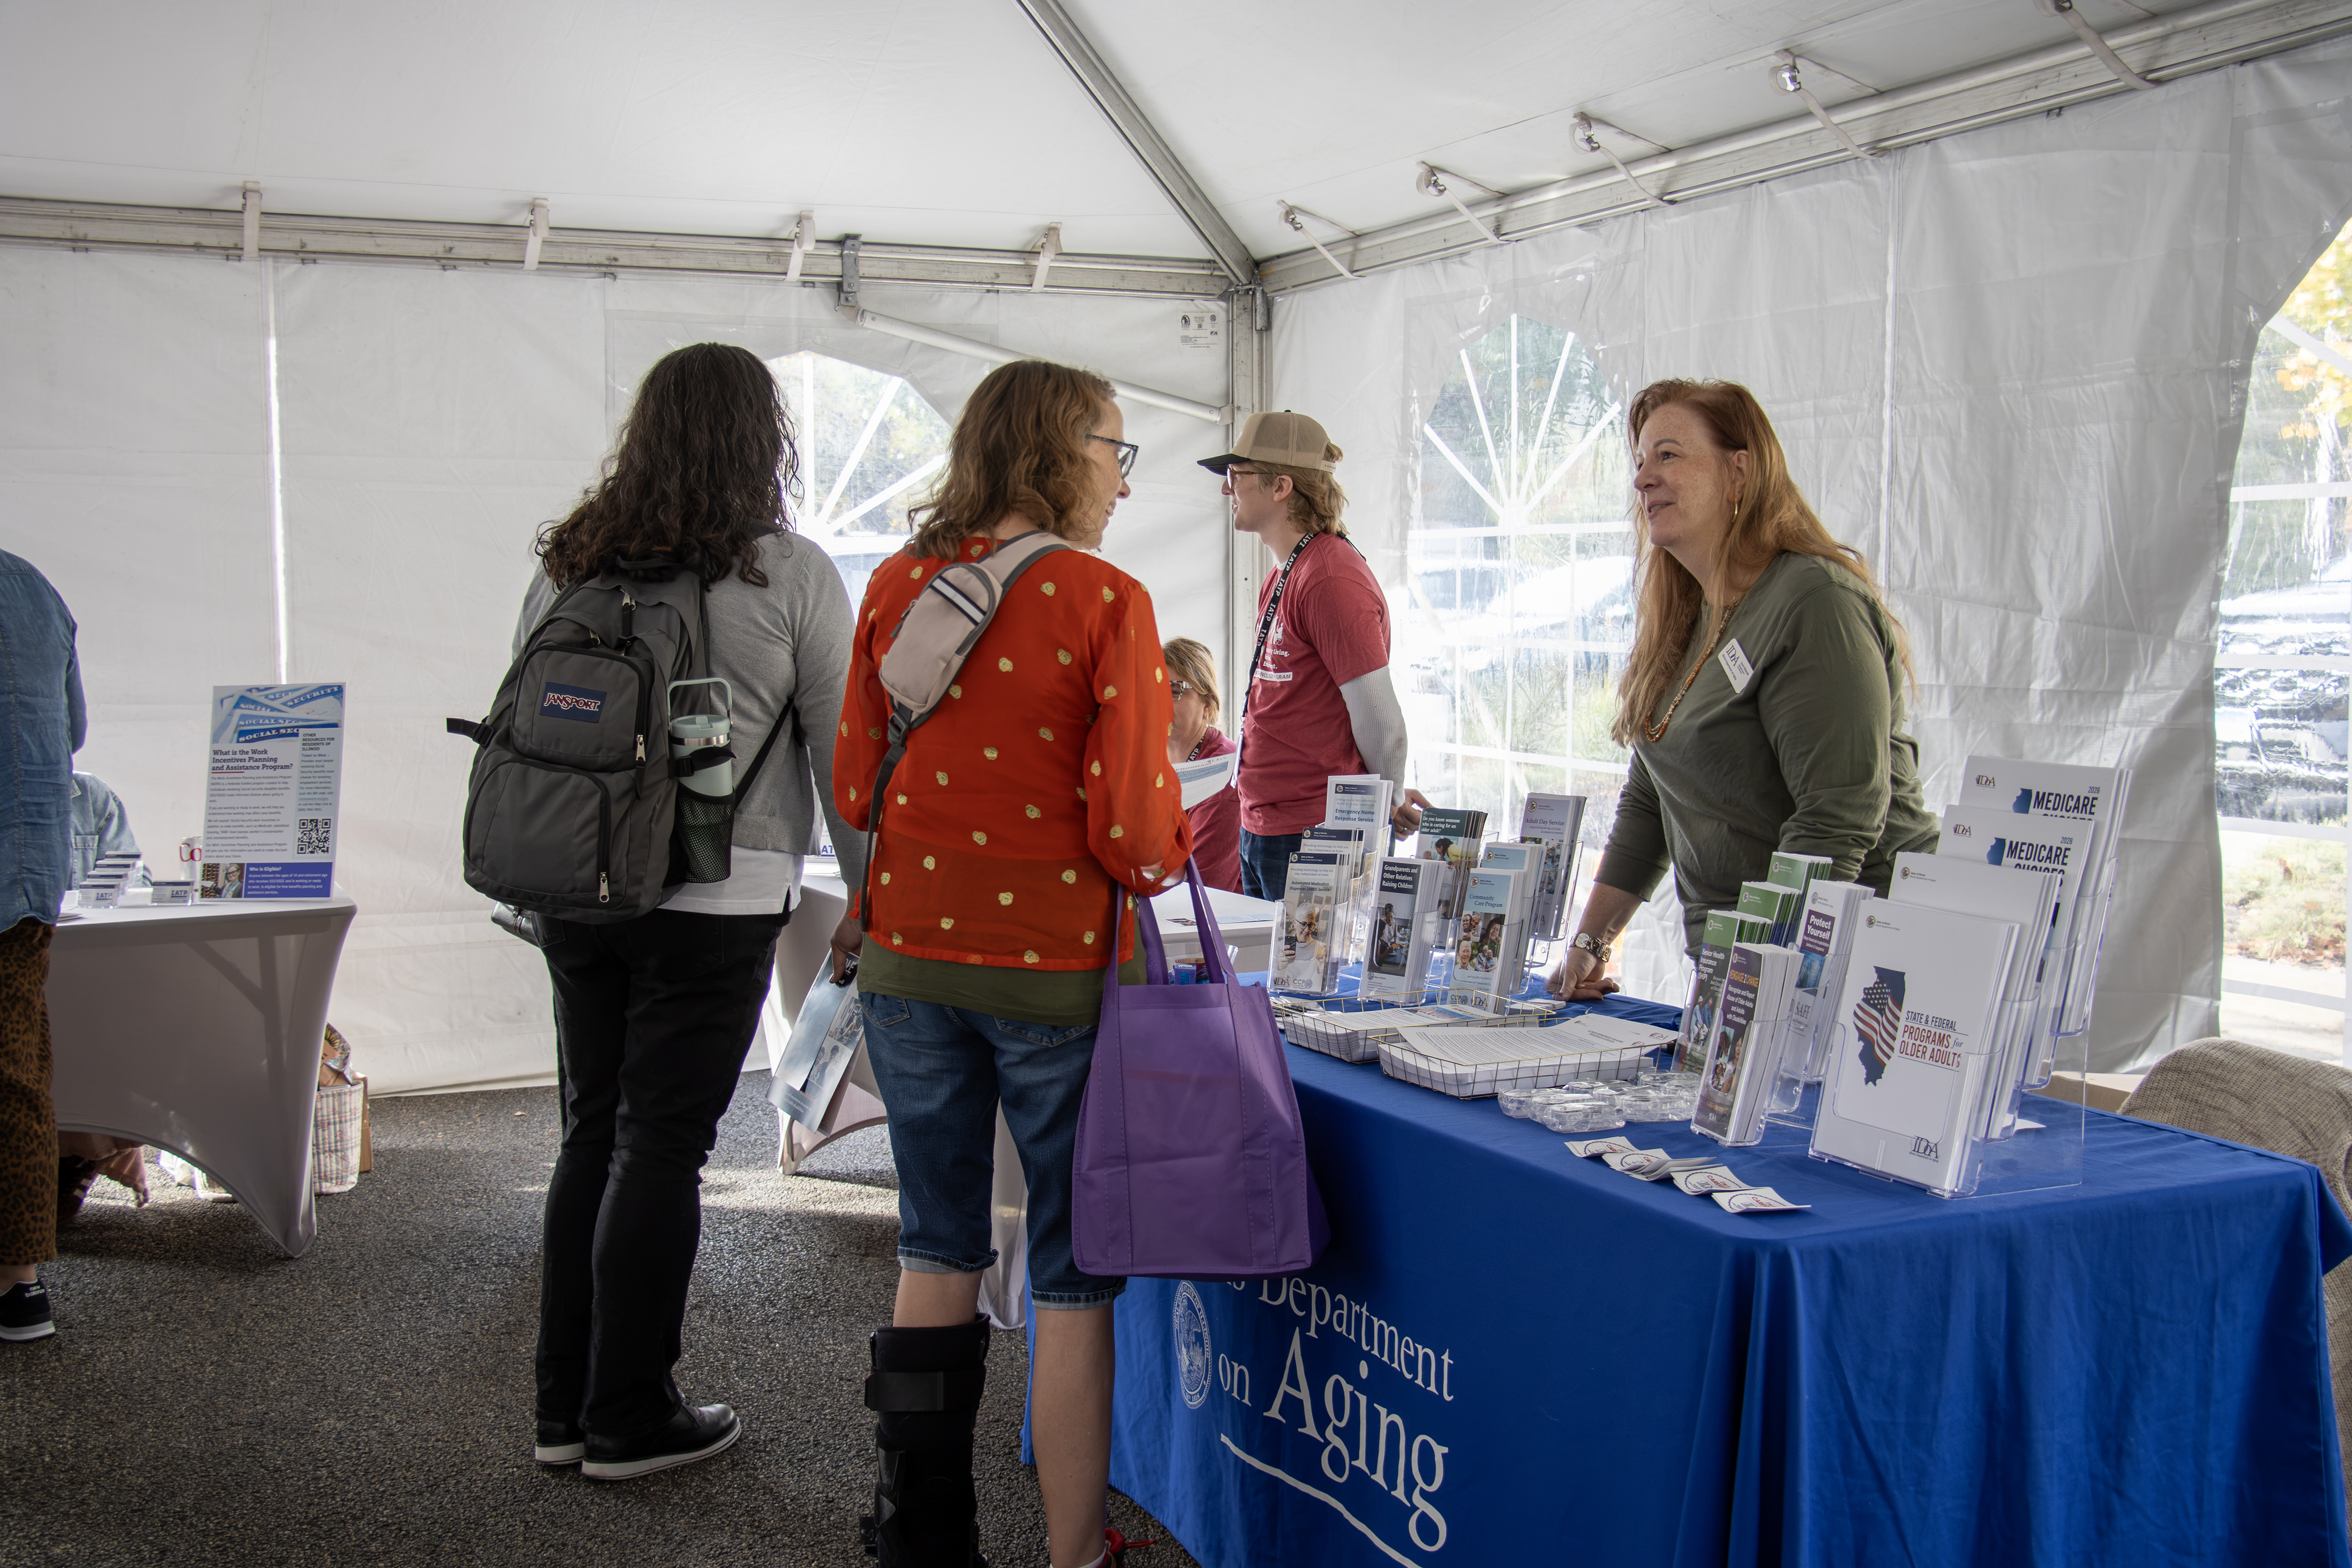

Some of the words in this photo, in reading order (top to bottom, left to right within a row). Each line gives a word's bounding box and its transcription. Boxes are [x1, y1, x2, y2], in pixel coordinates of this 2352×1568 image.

[1286, 552, 1297, 571] IATP
[1276, 578, 1285, 596] IATP
[1266, 603, 1276, 621] IATP
[287, 686, 339, 706] SECURITY
[544, 693, 601, 711] JANSPORT
[238, 730, 277, 743] SOCIAL
[2088, 786, 2100, 794] 2026
[2033, 791, 2098, 815] MEDICARE
[2060, 836, 2073, 845] 2026
[2006, 840, 2071, 866] MEDICARE
[1809, 915, 1831, 929] Protect
[1807, 925, 1830, 940] Yourself
[1700, 956, 1716, 966] Insurance
[1713, 950, 1725, 960] Health
[1698, 972, 1708, 982] (SHIP)
[1699, 965, 1713, 974] Program
[1728, 985, 1741, 994] Recognize
[1746, 990, 1755, 999] Report
[1732, 1014, 1746, 1024] Disabilities
[1736, 1006, 1745, 1014] Adults
[1906, 1010, 1924, 1023] STATE
[1924, 1015, 1929, 1025] &
[1931, 1016, 1956, 1031] FEDERAL
[1902, 1024, 1951, 1048] PROGRAMS
[1951, 1037, 1963, 1049] for
[1899, 1040, 1928, 1060] OLDER
[1928, 1047, 1961, 1068] ADULTS
[1911, 1135, 1939, 1159] IDoA
[1183, 1285, 1194, 1298] STATE
[1194, 1297, 1200, 1308] OF
[1259, 1277, 1454, 1401] Department
[1192, 1392, 1200, 1402] 1818
[1218, 1353, 1252, 1406] on
[1263, 1327, 1448, 1552] Aging
